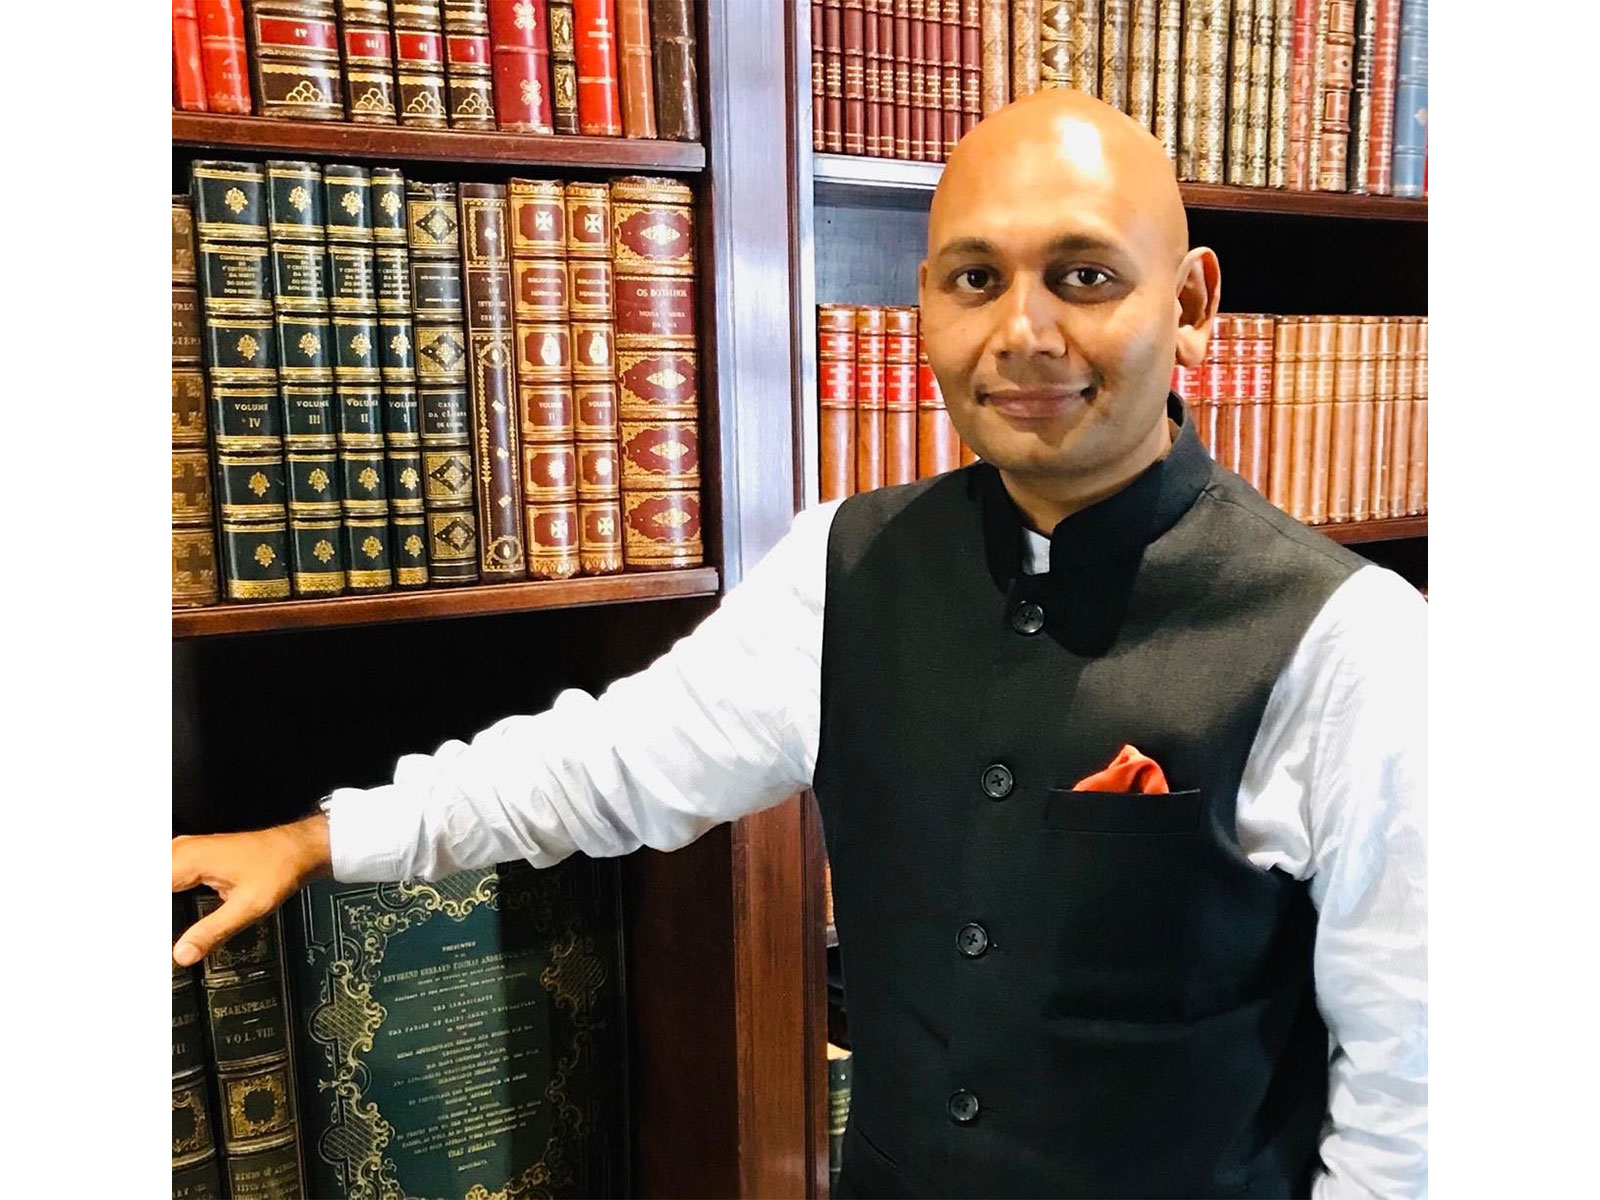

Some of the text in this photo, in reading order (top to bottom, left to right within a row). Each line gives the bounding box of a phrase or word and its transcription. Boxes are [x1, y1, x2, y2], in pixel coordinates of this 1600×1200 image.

[636, 289, 648, 297] OS
[249, 418, 261, 428] IV
[309, 414, 321, 424] III
[361, 413, 369, 423] II
